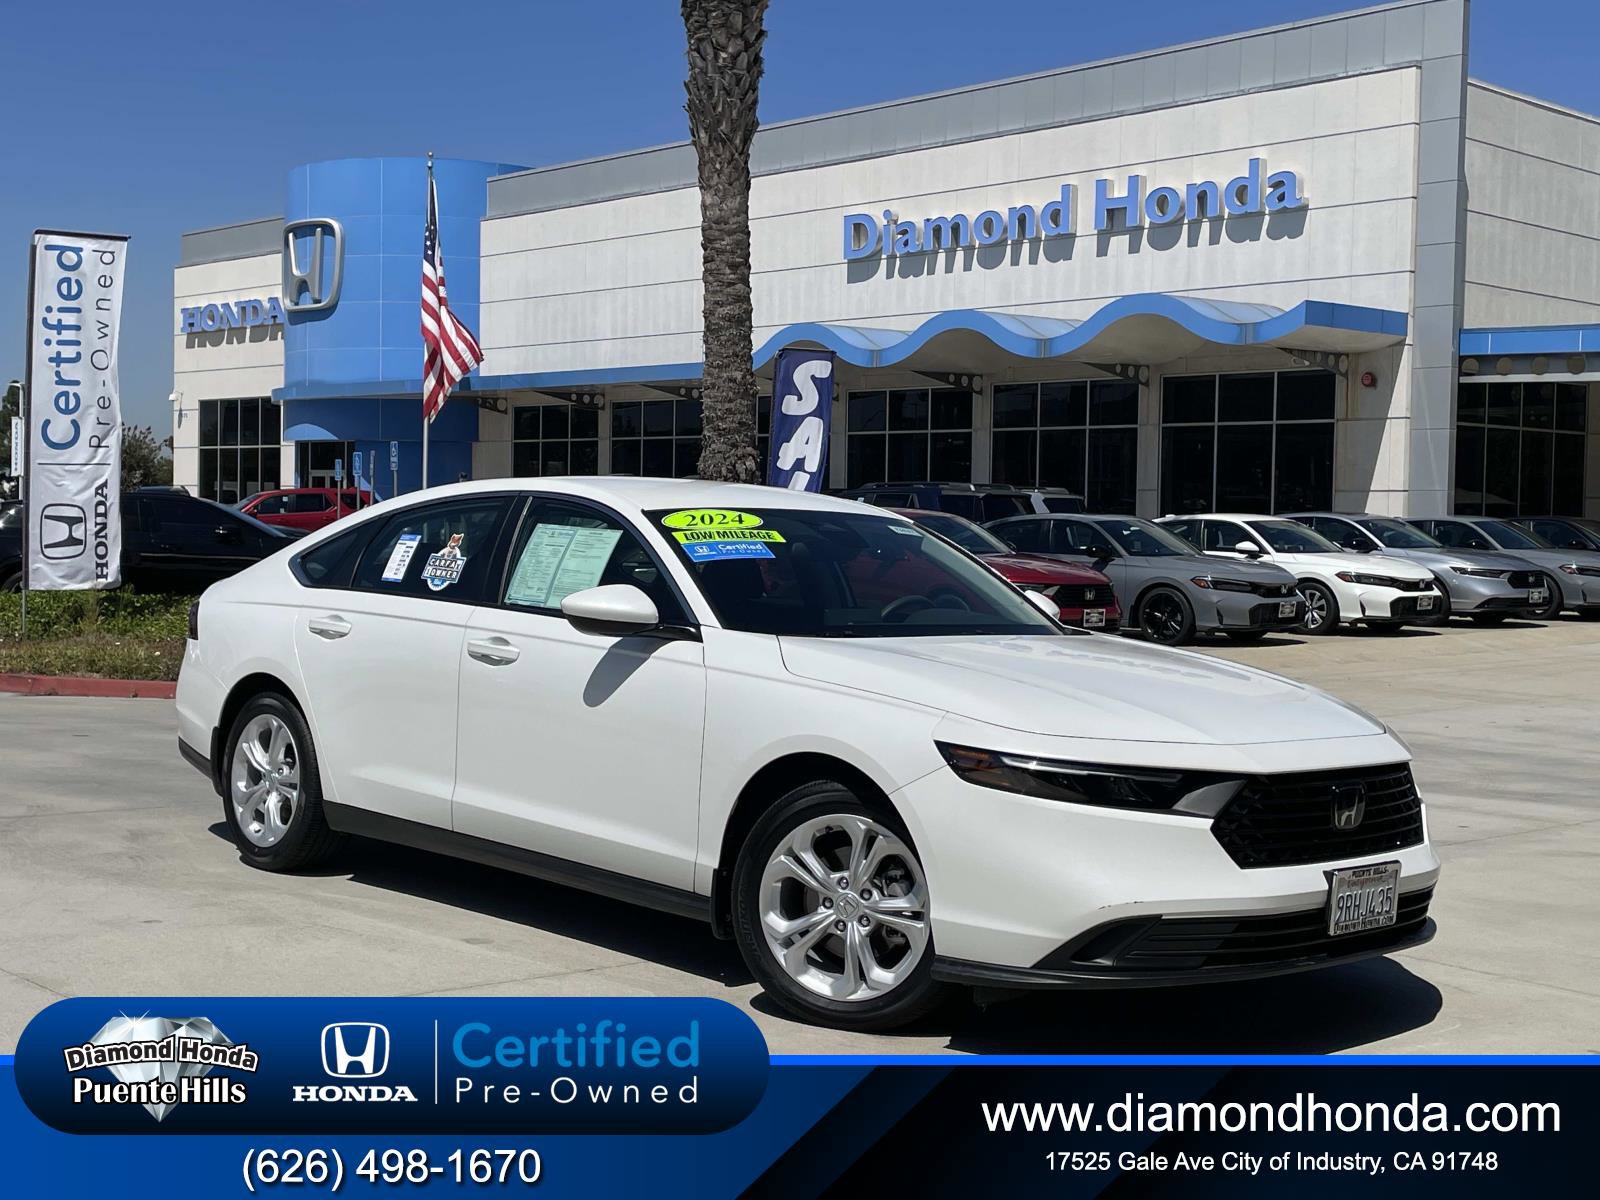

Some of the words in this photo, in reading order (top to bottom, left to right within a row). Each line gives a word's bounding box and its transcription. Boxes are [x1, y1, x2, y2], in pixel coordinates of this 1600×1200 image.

[843, 184, 1075, 260] Diamond
[1095, 157, 1306, 231] Honda
[180, 297, 284, 333] HONDA
[41, 244, 84, 451] Certified
[89, 249, 116, 449] Pre-Owned
[94, 479, 109, 581] HONDA
[684, 513, 745, 527] 2024
[683, 531, 714, 541] LOW
[716, 530, 776, 540] MILEAGE
[718, 543, 763, 551] Certified
[429, 558, 463, 571] CARFAX
[431, 568, 458, 579] OWNER
